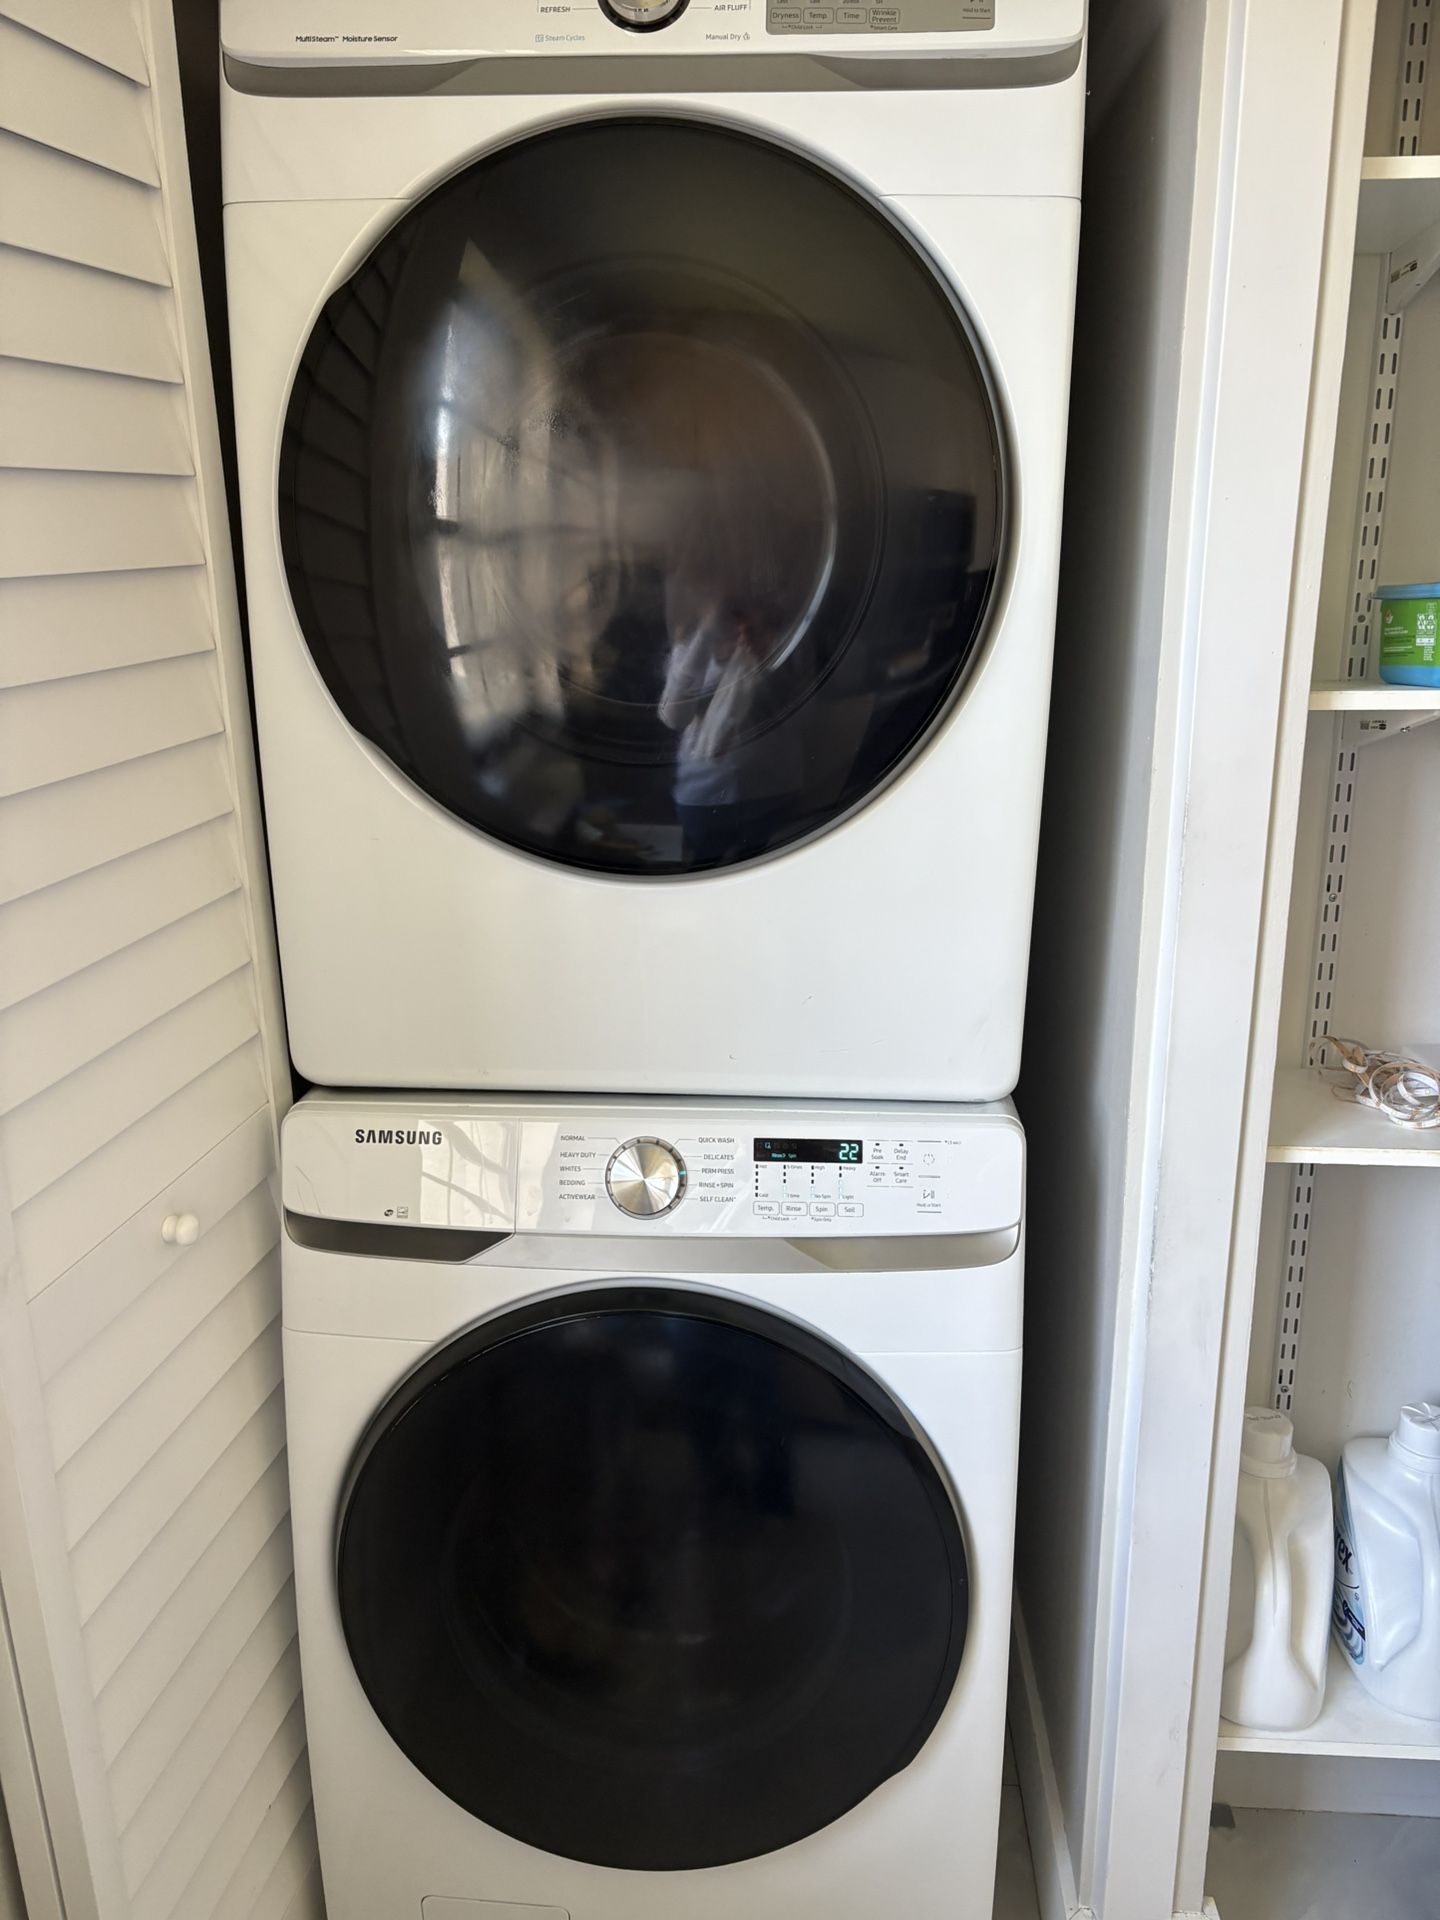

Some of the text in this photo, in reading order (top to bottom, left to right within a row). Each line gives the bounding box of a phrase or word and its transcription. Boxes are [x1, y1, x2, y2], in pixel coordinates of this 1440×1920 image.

[772, 12, 800, 21] Dryness
[809, 12, 828, 20] Temp
[566, 34, 586, 42] Cycles
[730, 33, 741, 42] Dry
[355, 1129, 443, 1145] SAMSUNG
[839, 1143, 859, 1160] 22
